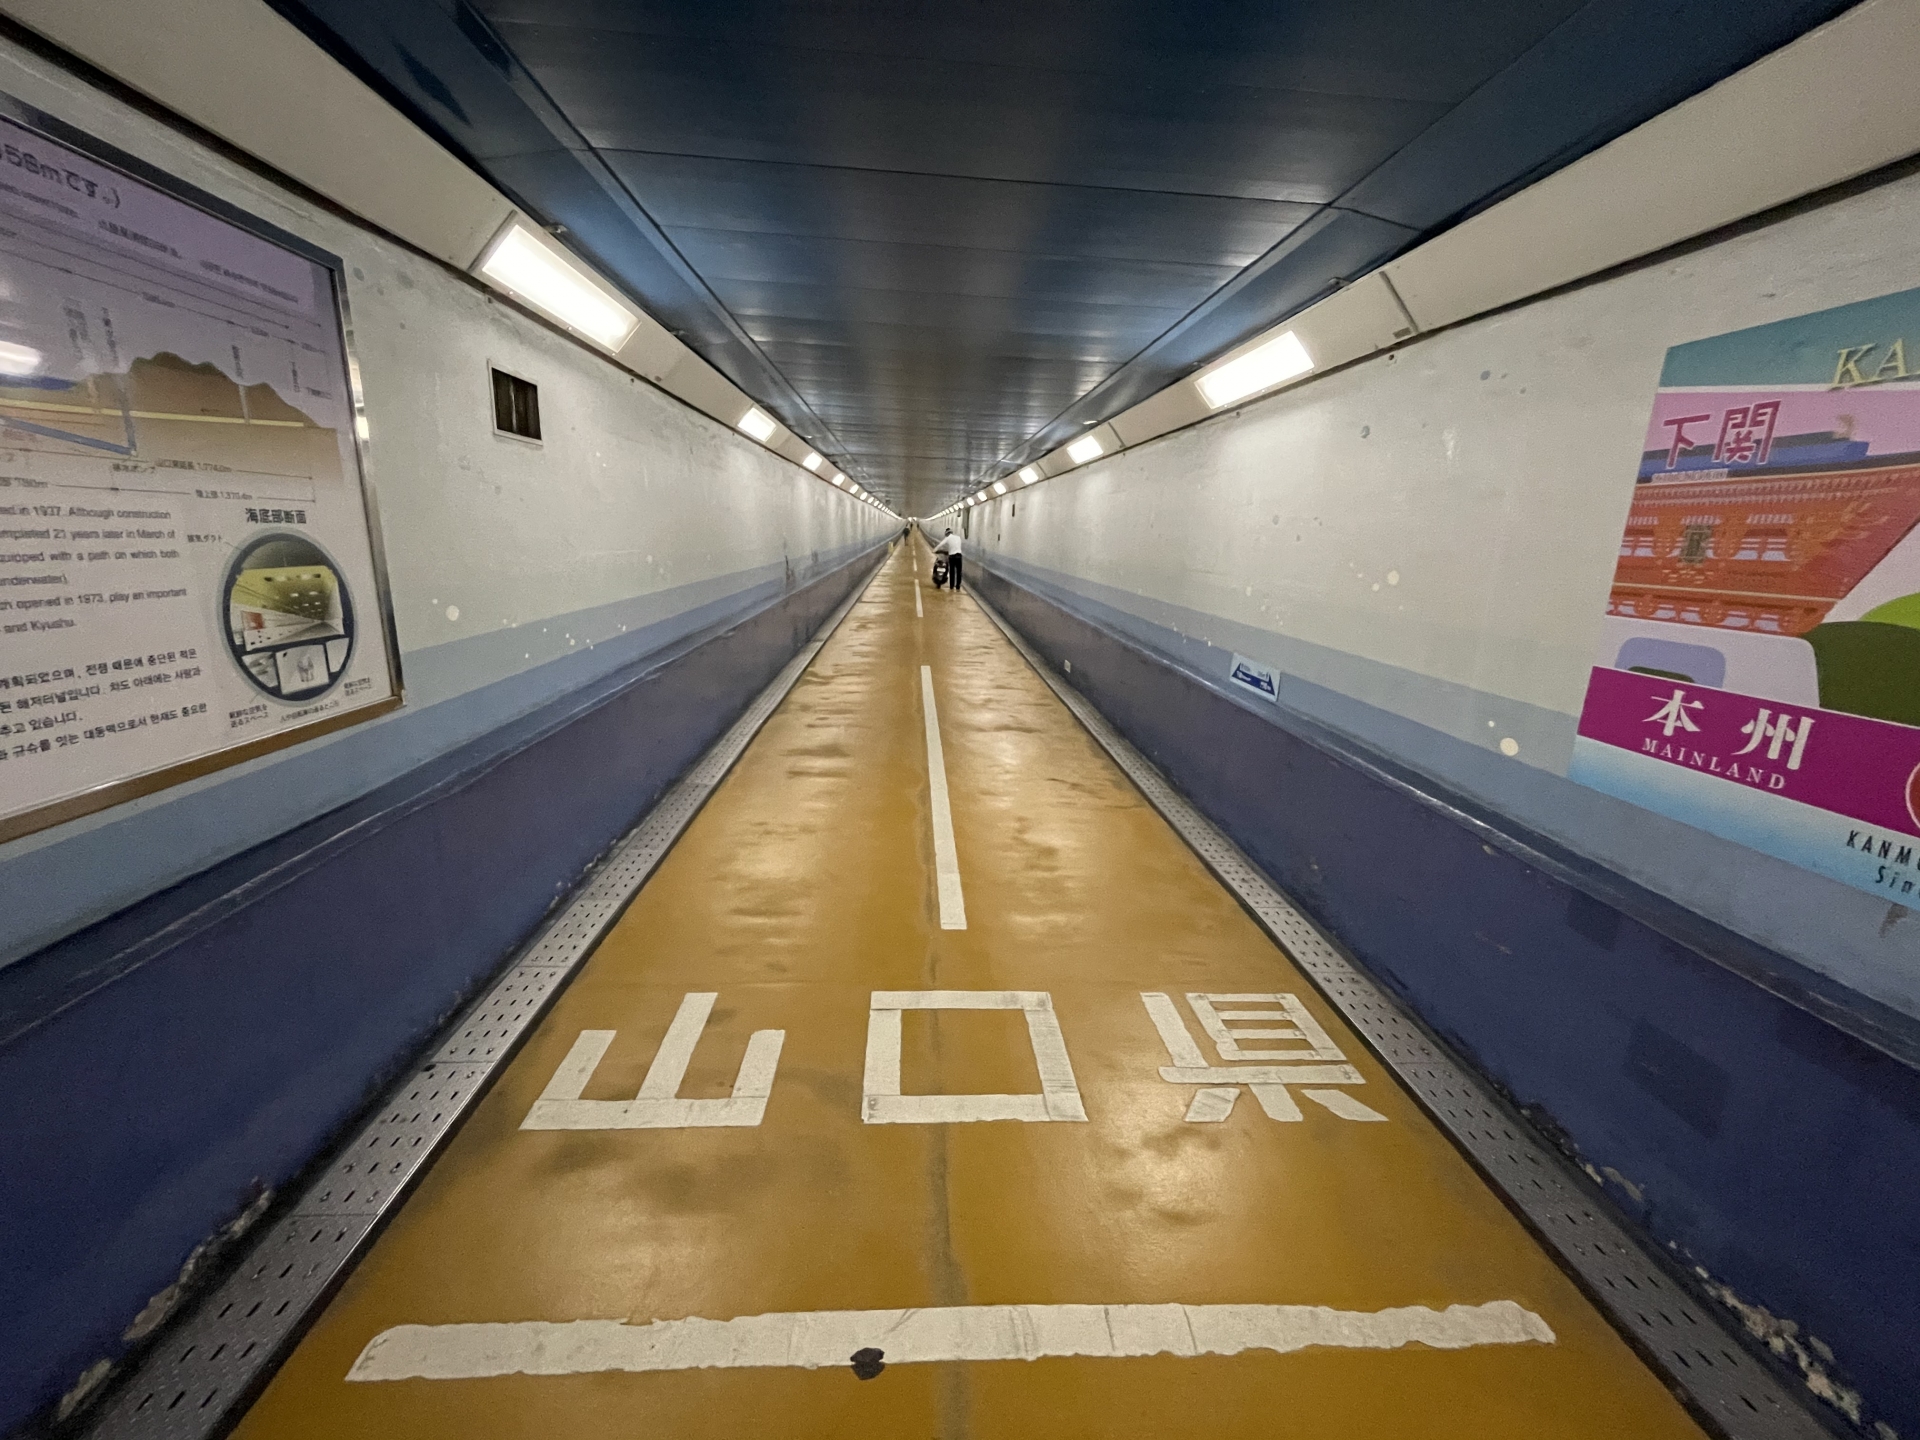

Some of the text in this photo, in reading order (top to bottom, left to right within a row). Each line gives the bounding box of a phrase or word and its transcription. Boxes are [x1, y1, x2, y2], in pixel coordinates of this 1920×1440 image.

[0, 143, 120, 209] 58mです。)
[1830, 337, 1920, 390] KA
[1662, 400, 1782, 470] 下関
[68, 507, 114, 520] Although
[117, 509, 171, 519] construction
[245, 507, 307, 524] 海底部断面
[70, 530, 100, 541] years
[102, 529, 123, 539] later
[136, 529, 166, 539] March
[167, 529, 176, 539] of
[50, 551, 72, 561] with
[77, 552, 84, 561] a
[88, 551, 111, 562] path
[115, 551, 127, 560] on
[130, 550, 157, 559] which
[160, 550, 180, 558] both
[16, 597, 61, 611] opened
[109, 592, 130, 604] play
[132, 592, 145, 600] an
[146, 588, 187, 599] important
[4, 622, 28, 634] and
[85, 662, 108, 676] 전쟁
[112, 657, 144, 671] 때문에
[109, 680, 131, 692] 차도
[133, 672, 172, 688] 아래에는
[174, 666, 202, 680] 사람과
[28, 711, 83, 731] 있습니다.
[150, 709, 179, 725] 현재도
[181, 702, 208, 718] 중요한
[1642, 689, 1816, 770] 本州
[1641, 737, 1786, 790] MAINLAND
[1846, 829, 1920, 872] KANM
[1875, 865, 1920, 899] Sin
[518, 991, 1390, 1132] 山口県
